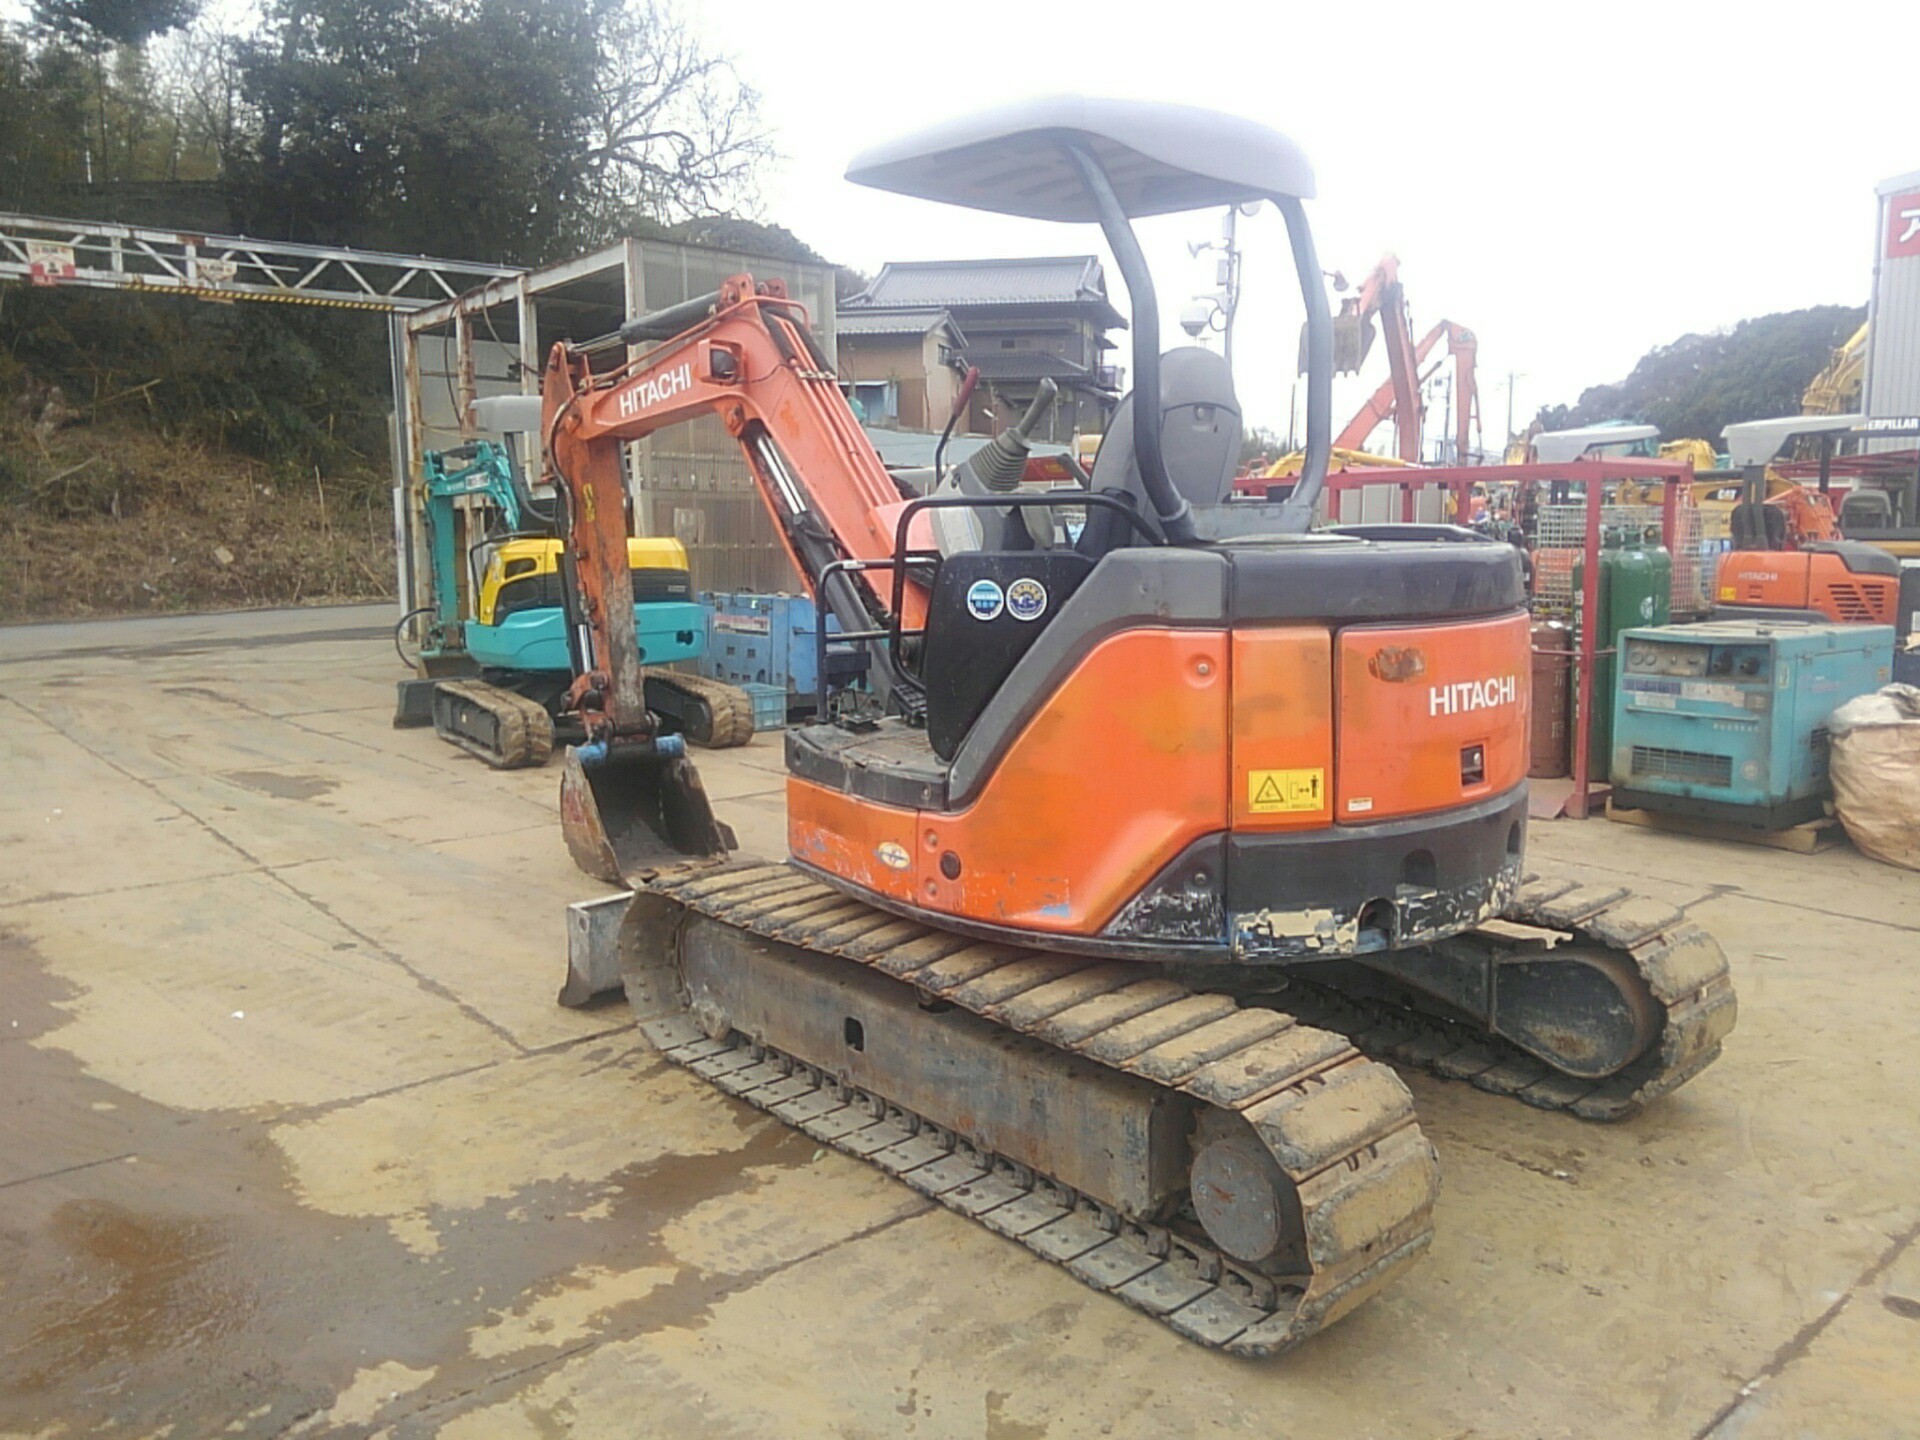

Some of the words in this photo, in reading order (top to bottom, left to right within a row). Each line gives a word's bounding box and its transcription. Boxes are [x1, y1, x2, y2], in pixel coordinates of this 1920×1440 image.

[619, 363, 692, 418] HITACHI
[1717, 488, 1737, 500] CAT
[1738, 571, 1778, 581] HITACHI
[1430, 675, 1515, 716] HITACHI
